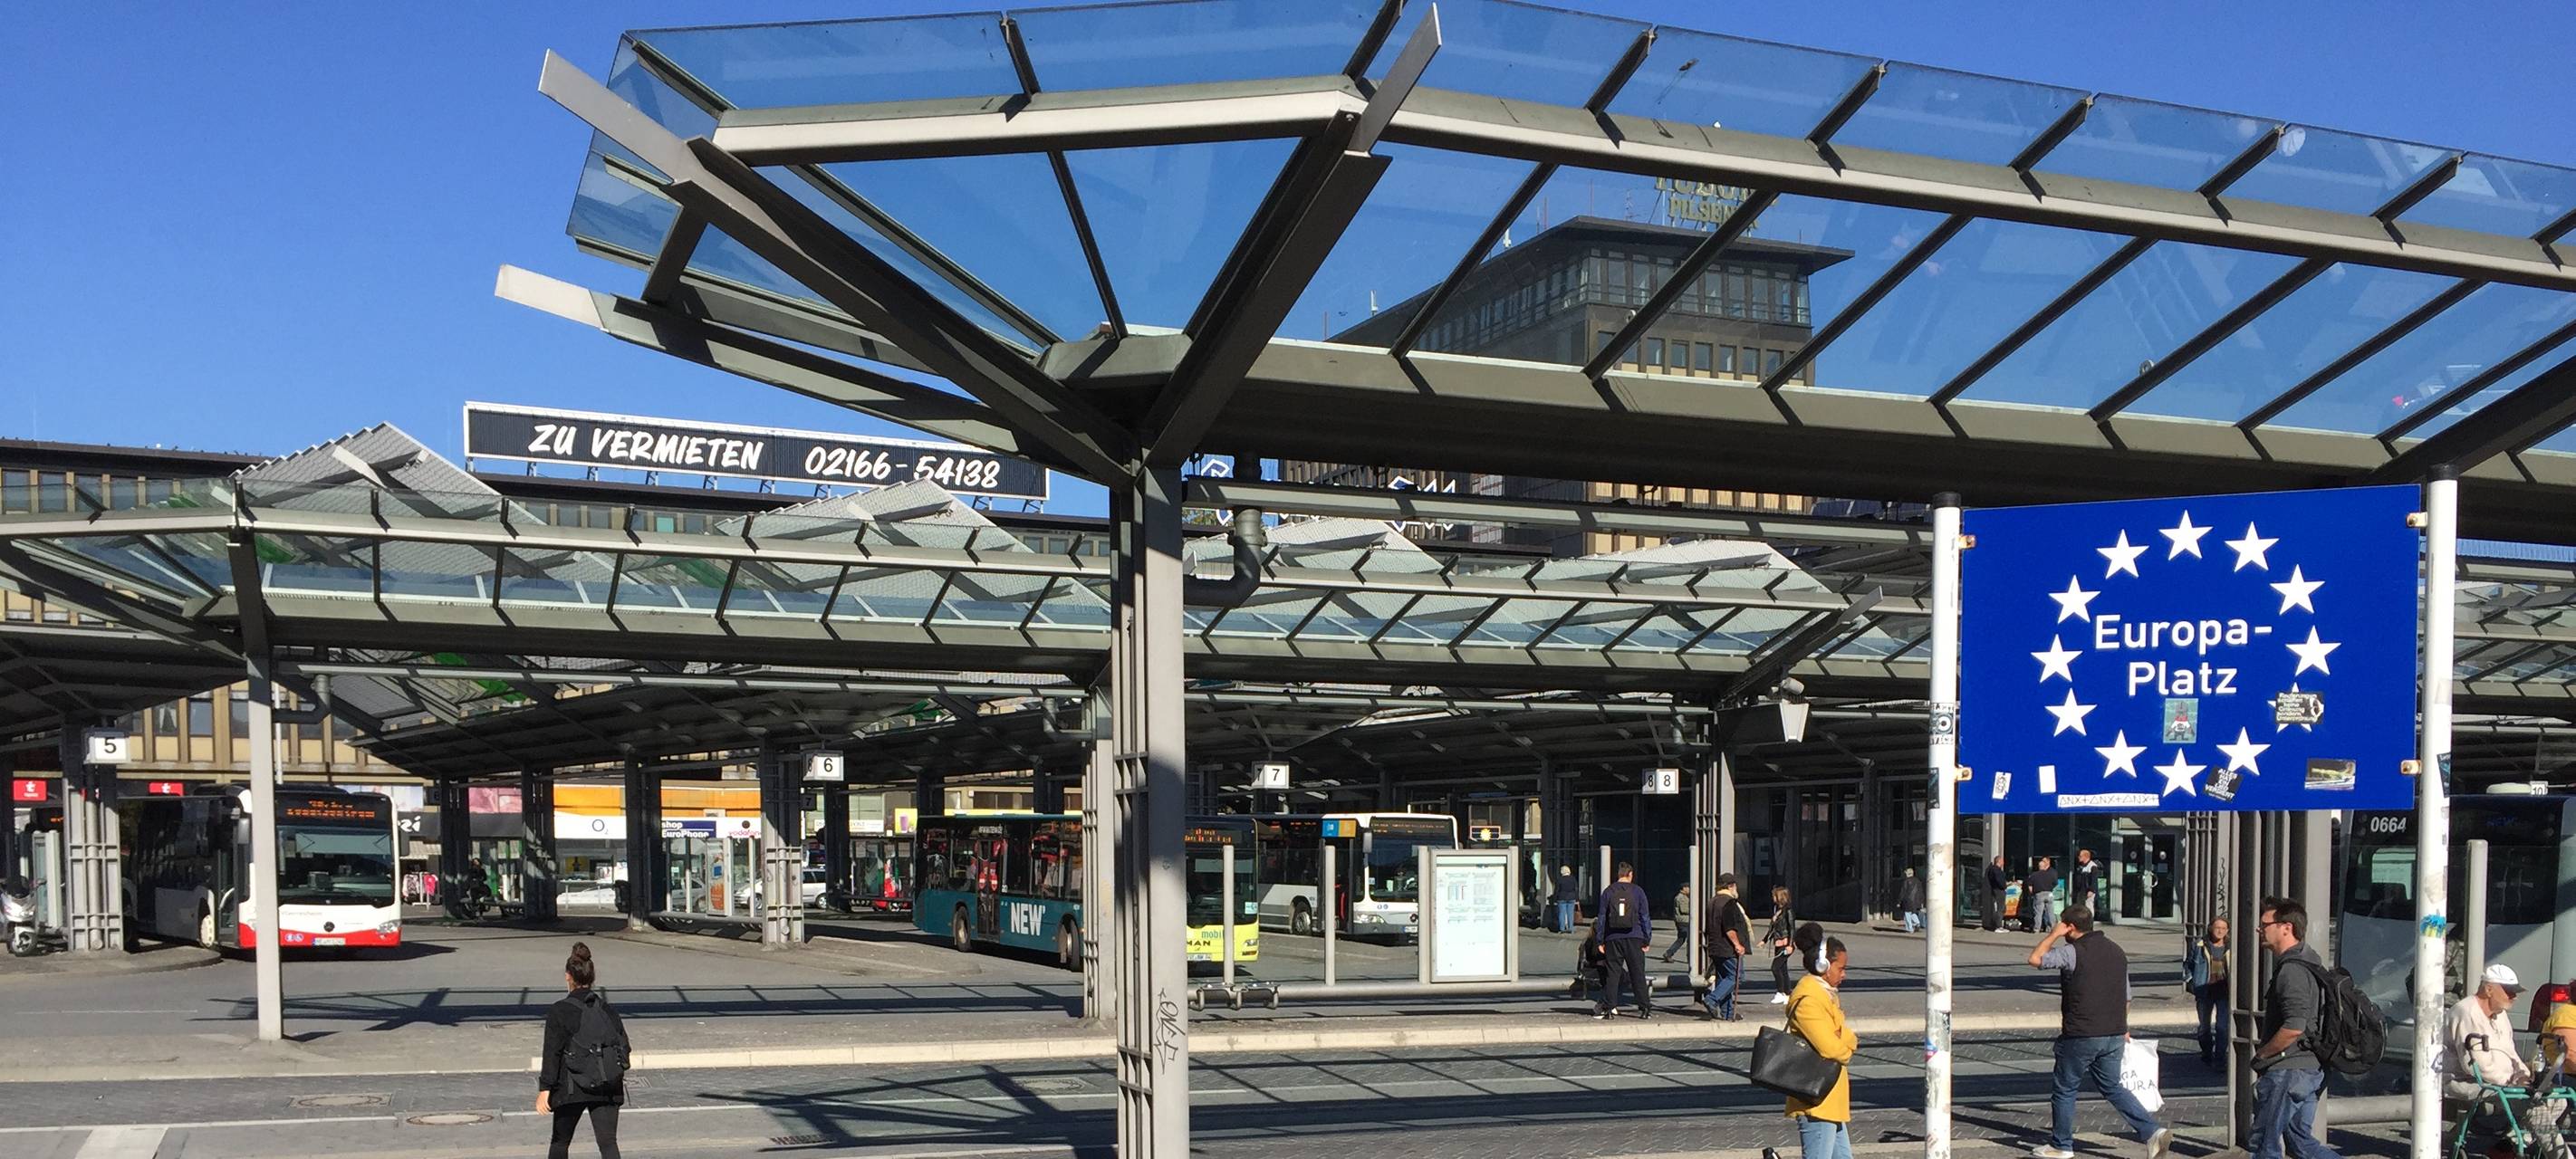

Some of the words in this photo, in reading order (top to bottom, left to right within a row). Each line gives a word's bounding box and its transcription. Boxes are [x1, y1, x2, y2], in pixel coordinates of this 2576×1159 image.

[527, 424, 577, 455] ZU
[591, 427, 764, 470] VERMIETEN
[2096, 614, 2273, 656] Europa-
[2129, 661, 2238, 696] Platz
[104, 736, 117, 753] 5
[823, 758, 833, 772] 6
[1272, 768, 1281, 781] 7
[1663, 774, 1671, 787] 8
[2370, 816, 2407, 833] 0664
